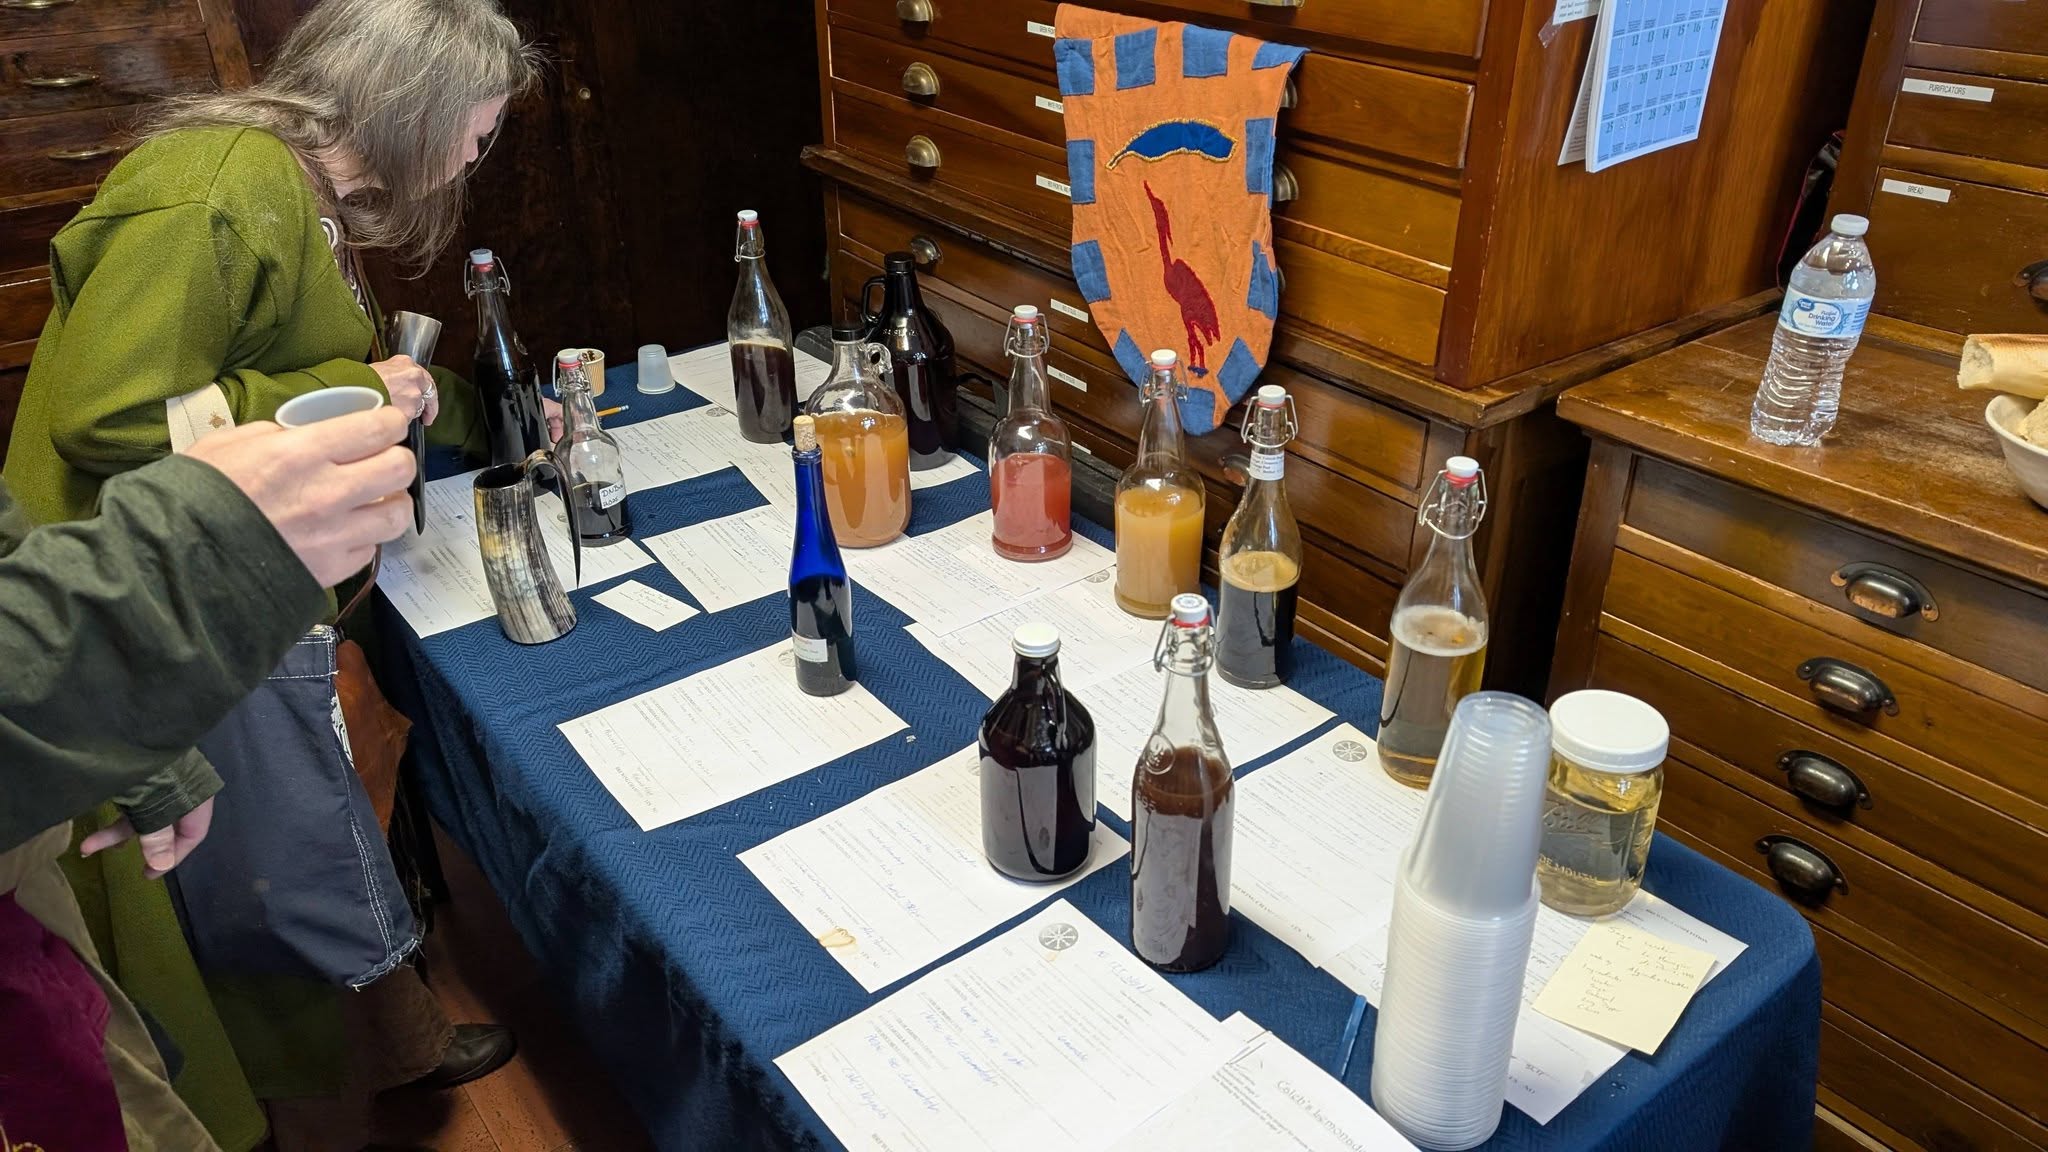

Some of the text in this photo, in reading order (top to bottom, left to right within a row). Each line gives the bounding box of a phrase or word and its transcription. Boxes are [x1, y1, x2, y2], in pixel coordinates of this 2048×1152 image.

[1632, 34, 1639, 46] 12
[1648, 31, 1654, 43] 13
[1662, 28, 1669, 40] 14
[1678, 24, 1685, 36] 15
[1693, 22, 1700, 33] 16
[1711, 19, 1718, 31] 17
[1656, 69, 1663, 80] 21
[1669, 65, 1678, 77] 22
[1685, 62, 1693, 73] 23
[1701, 59, 1709, 70] 24
[1928, 83, 1967, 96] PURIFICATORS
[1606, 121, 1614, 133] 25
[1634, 113, 1642, 125] 27
[1648, 108, 1657, 120] 28
[1663, 104, 1671, 116] 29
[1907, 185, 1924, 195] BREAD
[1808, 312, 1837, 322] Drinking
[1815, 319, 1835, 328] Water
[1277, 1080, 1366, 1152] Caleb's Lemonad
